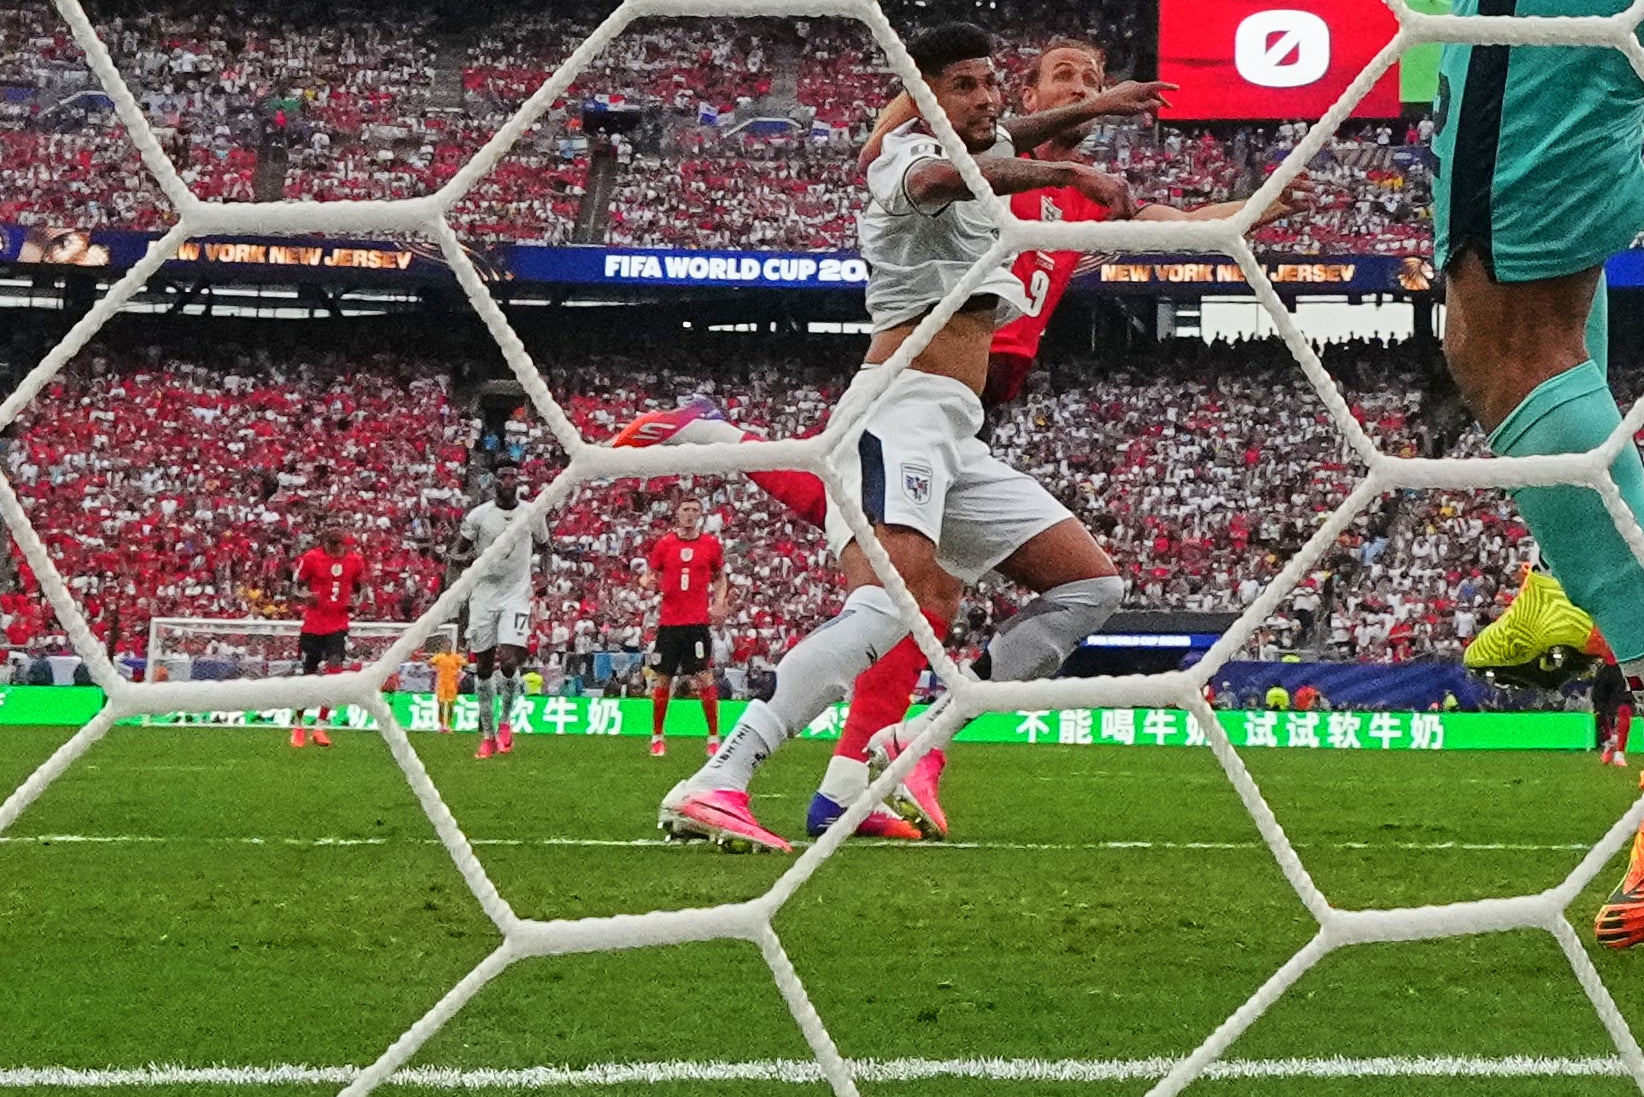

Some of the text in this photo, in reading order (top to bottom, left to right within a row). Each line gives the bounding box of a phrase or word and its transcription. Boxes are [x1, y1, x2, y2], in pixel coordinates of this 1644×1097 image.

[205, 243, 267, 263] YORK
[269, 245, 322, 266] NEW
[324, 248, 412, 269] JERSEY
[605, 255, 870, 282] FIFA WORLD CUP 20
[1101, 264, 1152, 282] NEW
[1155, 264, 1213, 282] YORK
[1270, 264, 1355, 282] JERSEY
[1030, 270, 1050, 317] 9
[514, 612, 528, 631] 17
[1244, 711, 1444, 750] 试试软牛奶
